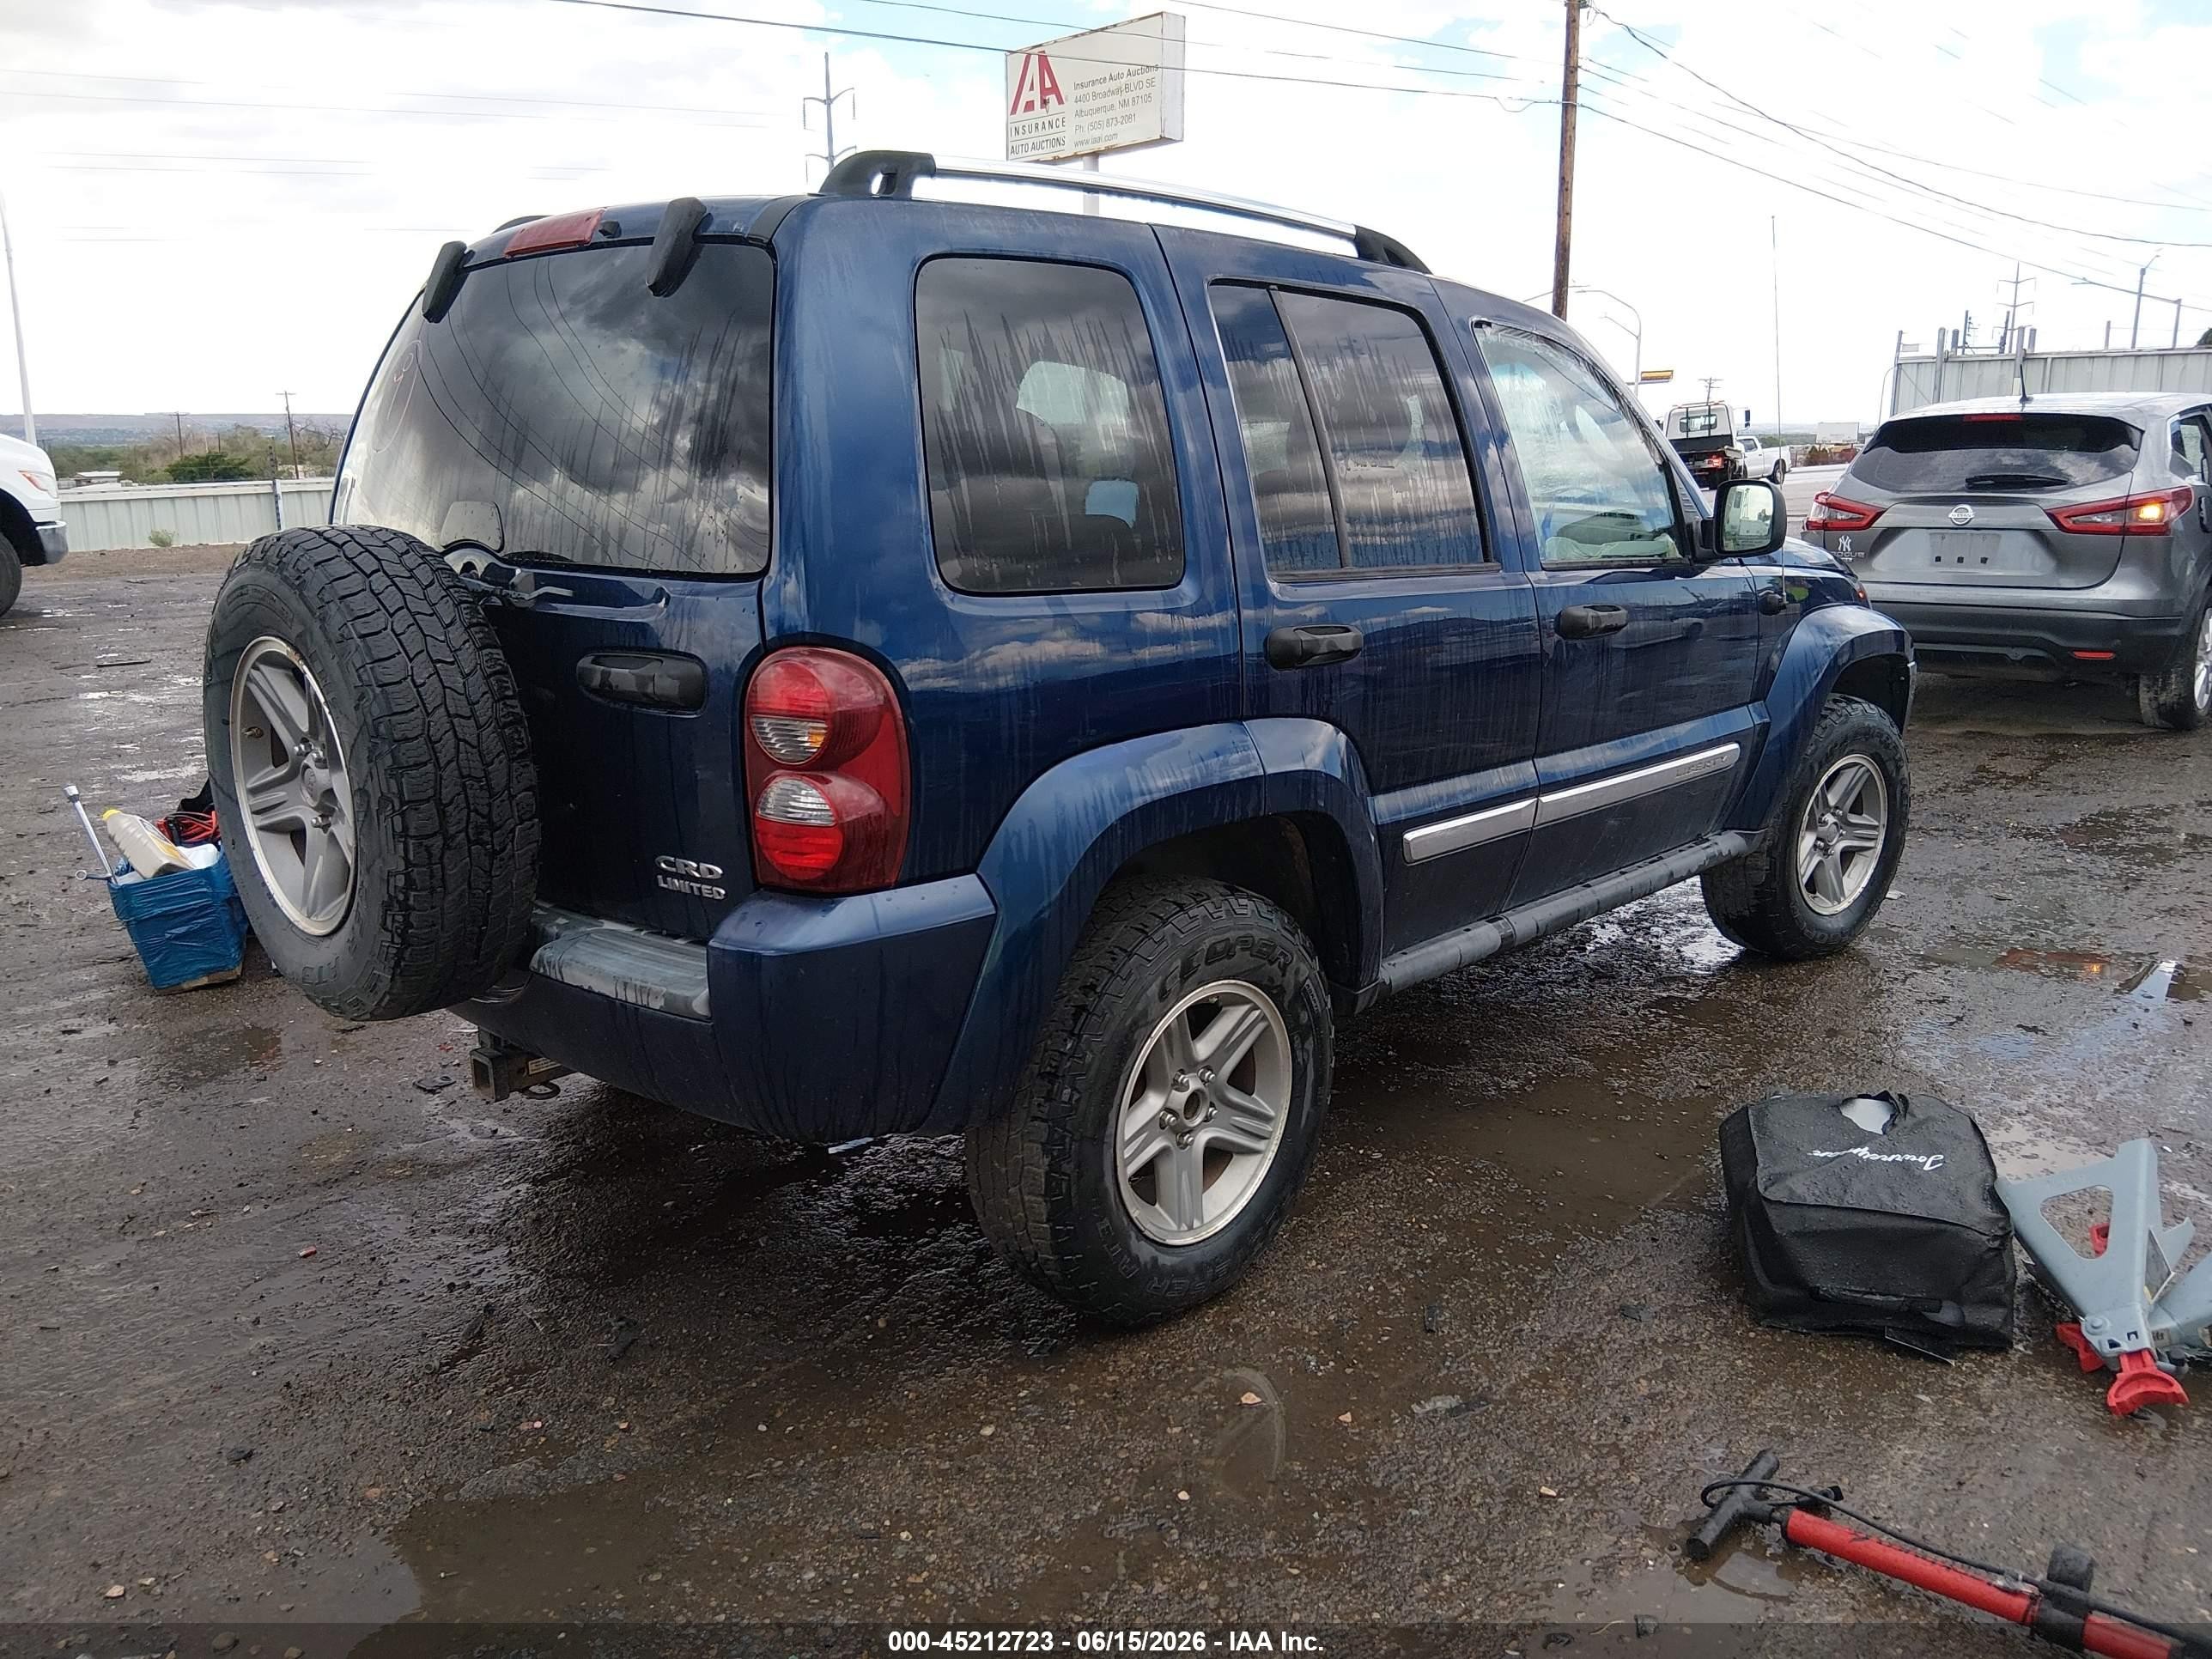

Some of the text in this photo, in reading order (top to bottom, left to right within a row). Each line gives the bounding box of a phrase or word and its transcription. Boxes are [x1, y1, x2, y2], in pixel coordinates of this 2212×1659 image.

[1073, 64, 1159, 90] Insurance Auto Auctions
[1073, 77, 1156, 104] 4400 Broadway BLVD SE
[1118, 98, 1130, 110] NM
[1131, 93, 1152, 106] 87105
[1010, 117, 1066, 137] INSURANCE
[1087, 119, 1104, 134] (505)
[1105, 112, 1136, 129] 873-2081
[1010, 135, 1066, 156] AUTO AUCTIONS
[654, 854, 724, 879] CRD
[656, 874, 726, 900] LIMITED
